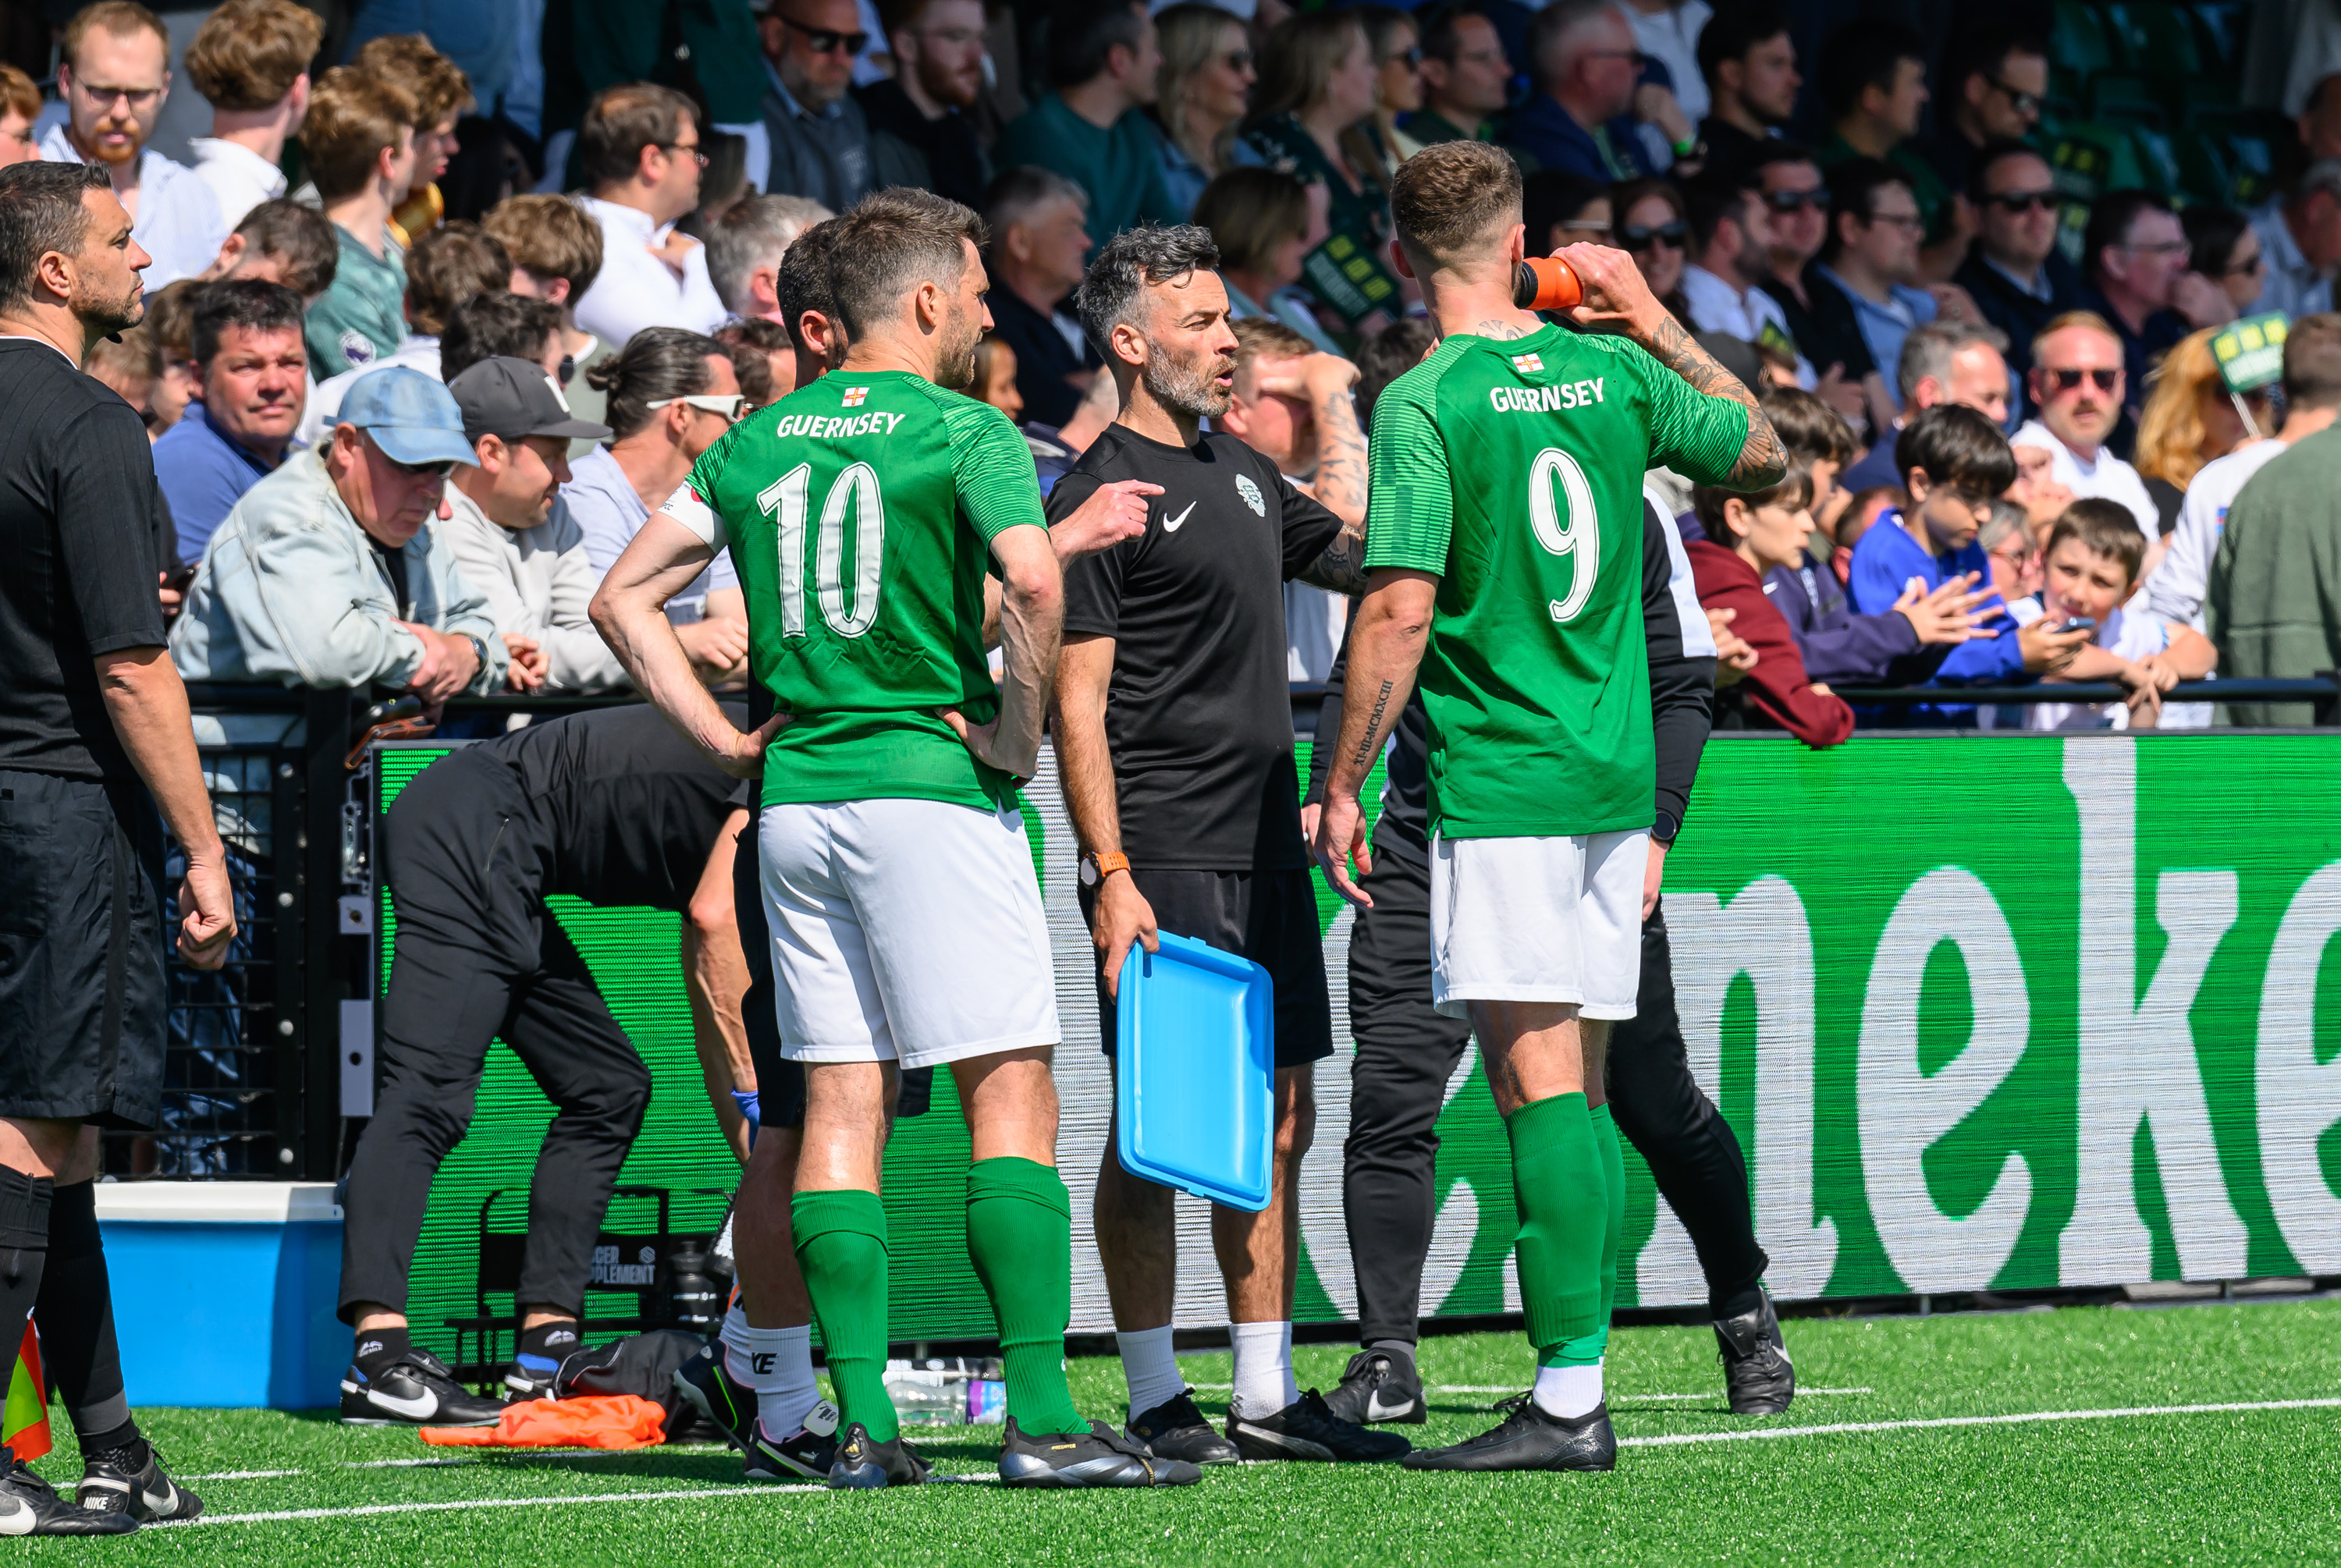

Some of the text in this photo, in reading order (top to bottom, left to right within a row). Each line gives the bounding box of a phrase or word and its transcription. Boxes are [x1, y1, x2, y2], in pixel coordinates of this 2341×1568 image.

[1489, 377, 1604, 413] GUERNSEY
[777, 411, 906, 438] GUERNSEY
[756, 461, 886, 639] 10
[1527, 446, 1600, 623] 9
[83, 1496, 109, 1511] NIKE
